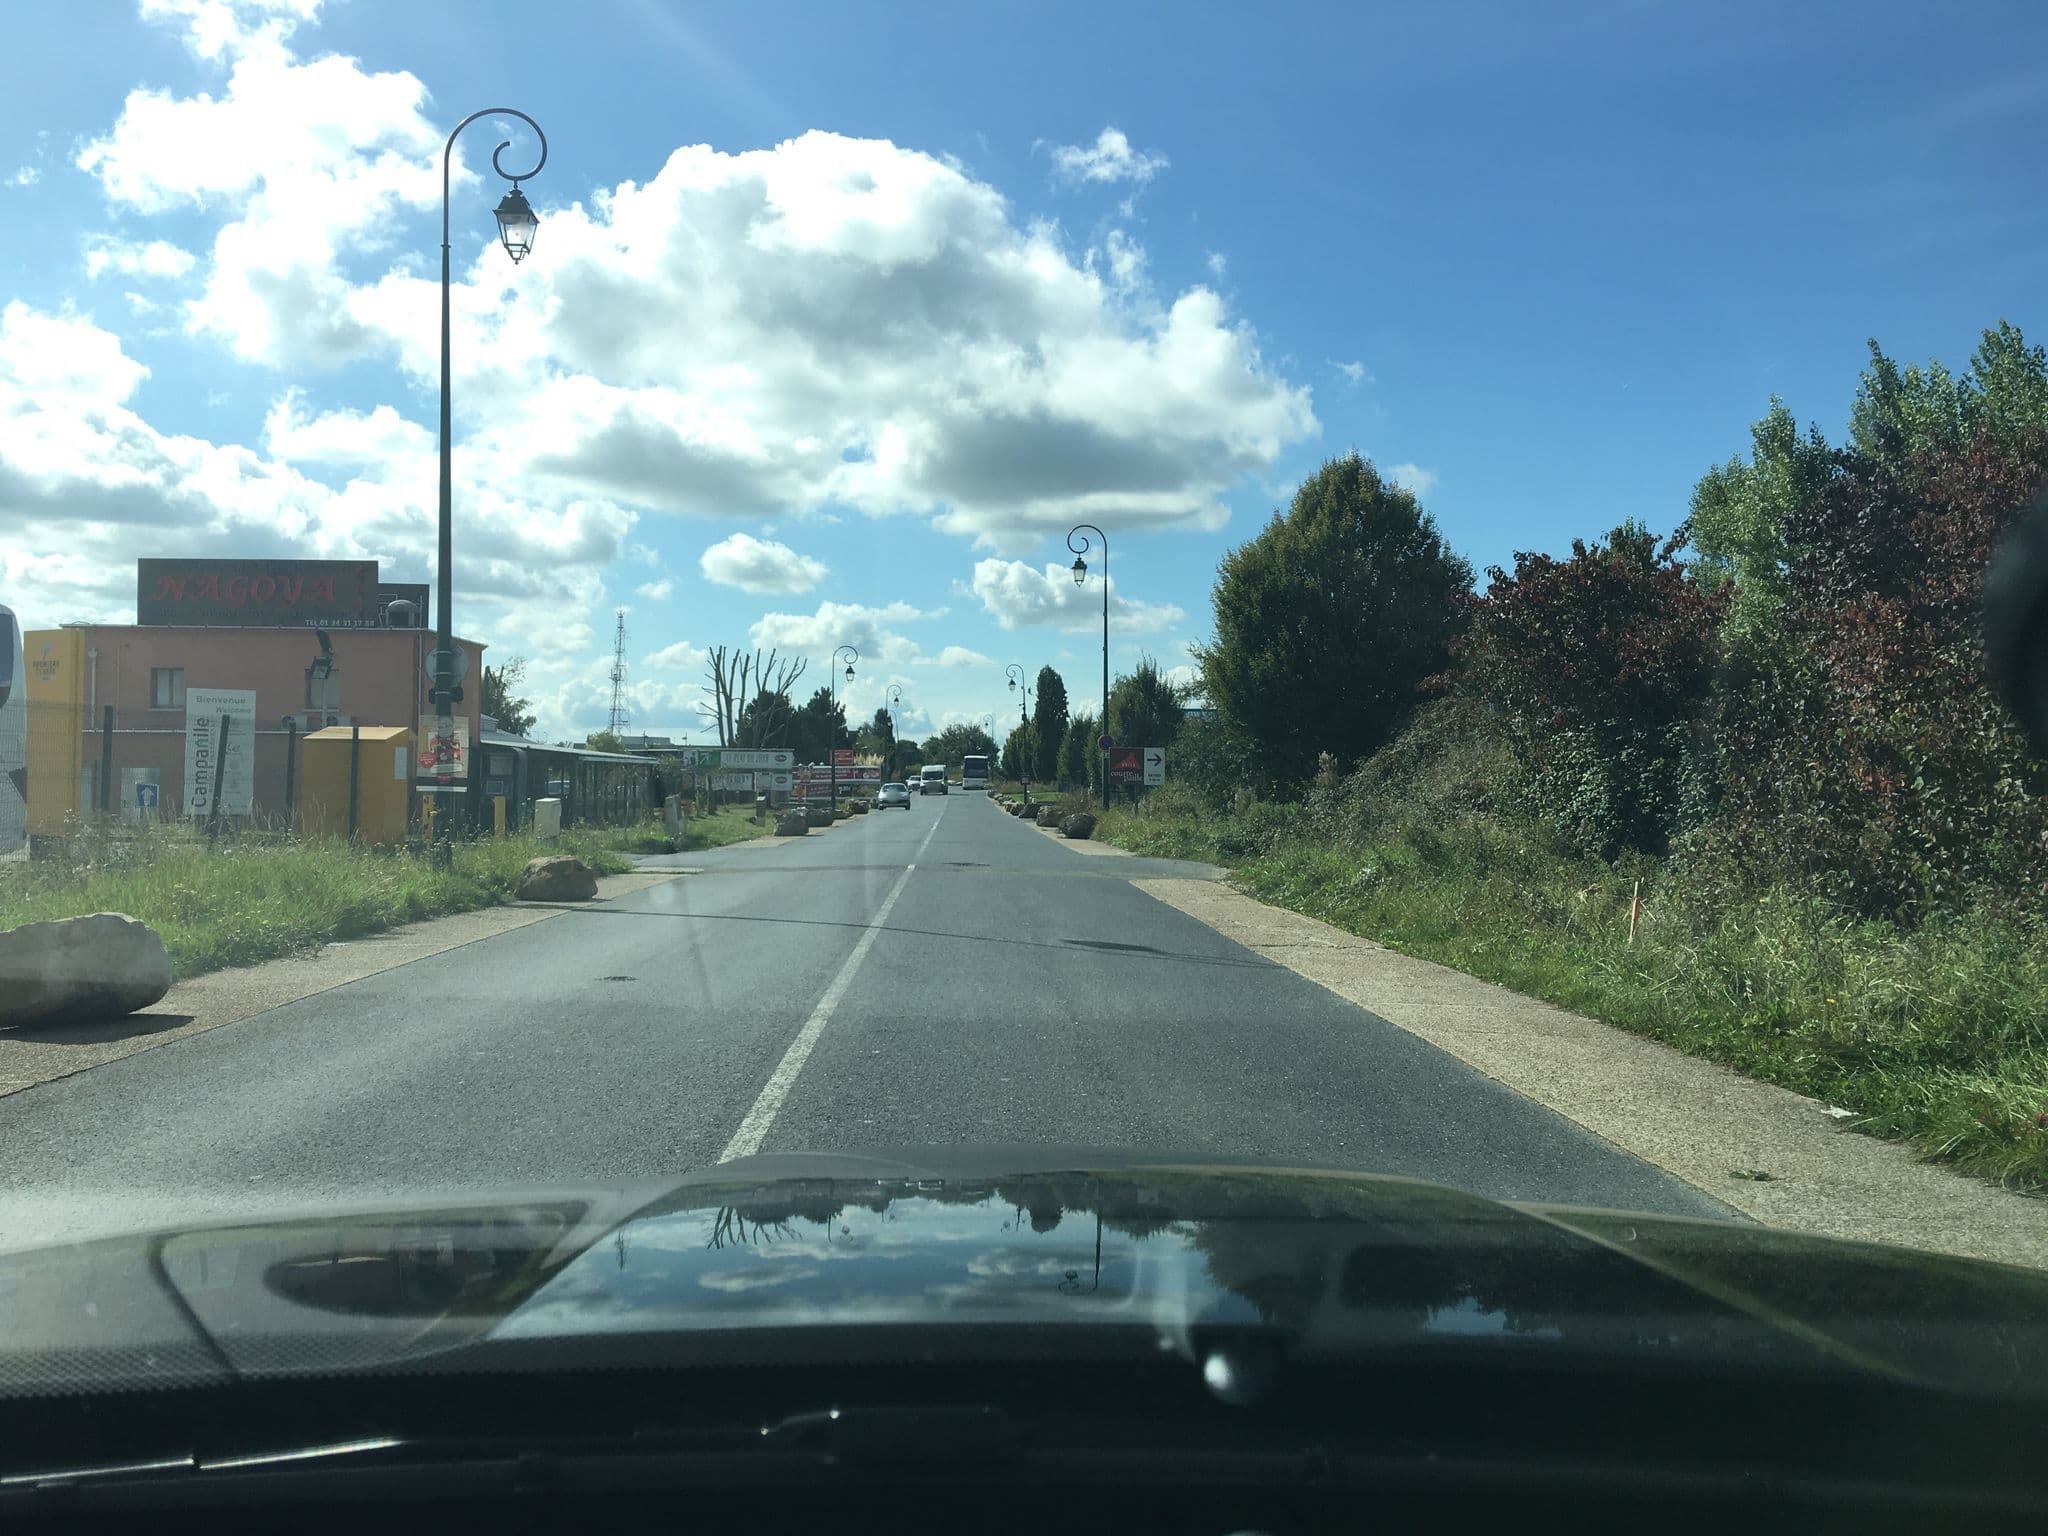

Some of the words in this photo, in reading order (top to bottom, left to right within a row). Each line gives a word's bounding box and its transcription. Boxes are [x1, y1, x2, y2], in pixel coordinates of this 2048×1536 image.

[150, 575, 334, 608] NAGOYA
[196, 695, 246, 704] Bienvenue
[191, 717, 213, 808] Campanile
